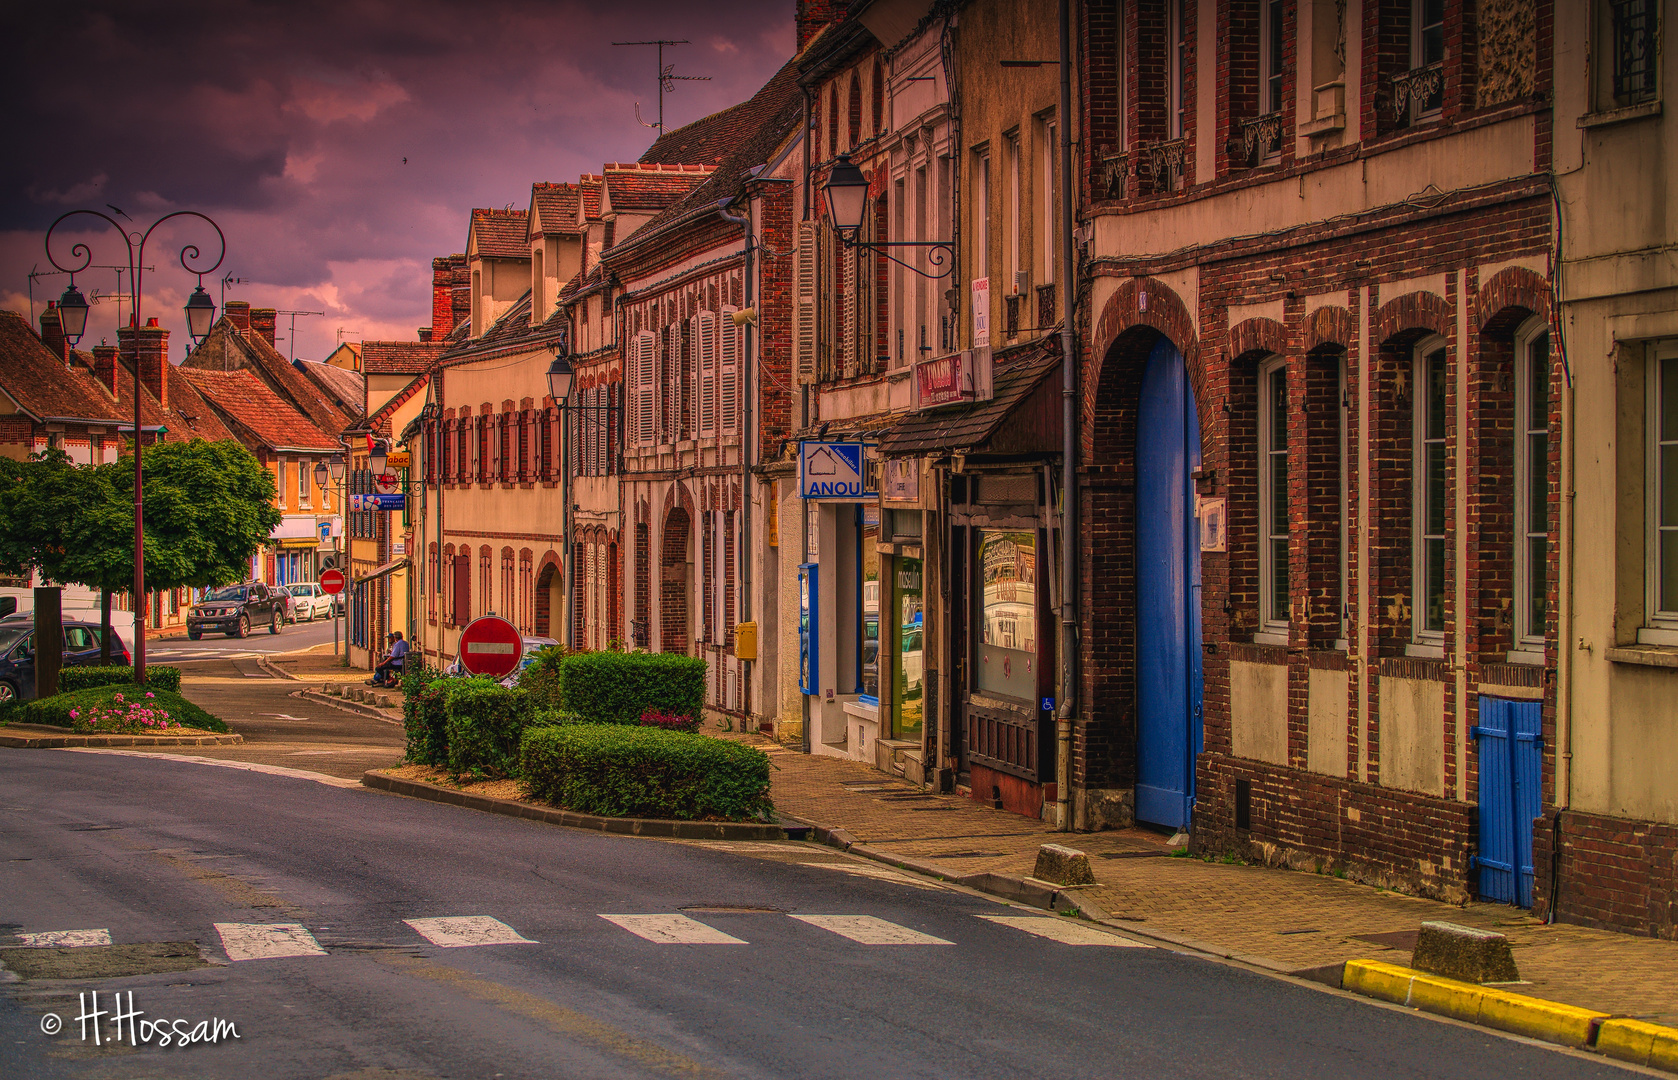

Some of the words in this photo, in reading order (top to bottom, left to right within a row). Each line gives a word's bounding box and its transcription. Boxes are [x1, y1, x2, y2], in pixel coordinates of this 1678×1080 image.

[387, 455, 409, 464] abac
[834, 447, 857, 469] immobilier
[809, 482, 860, 495] ANOU
